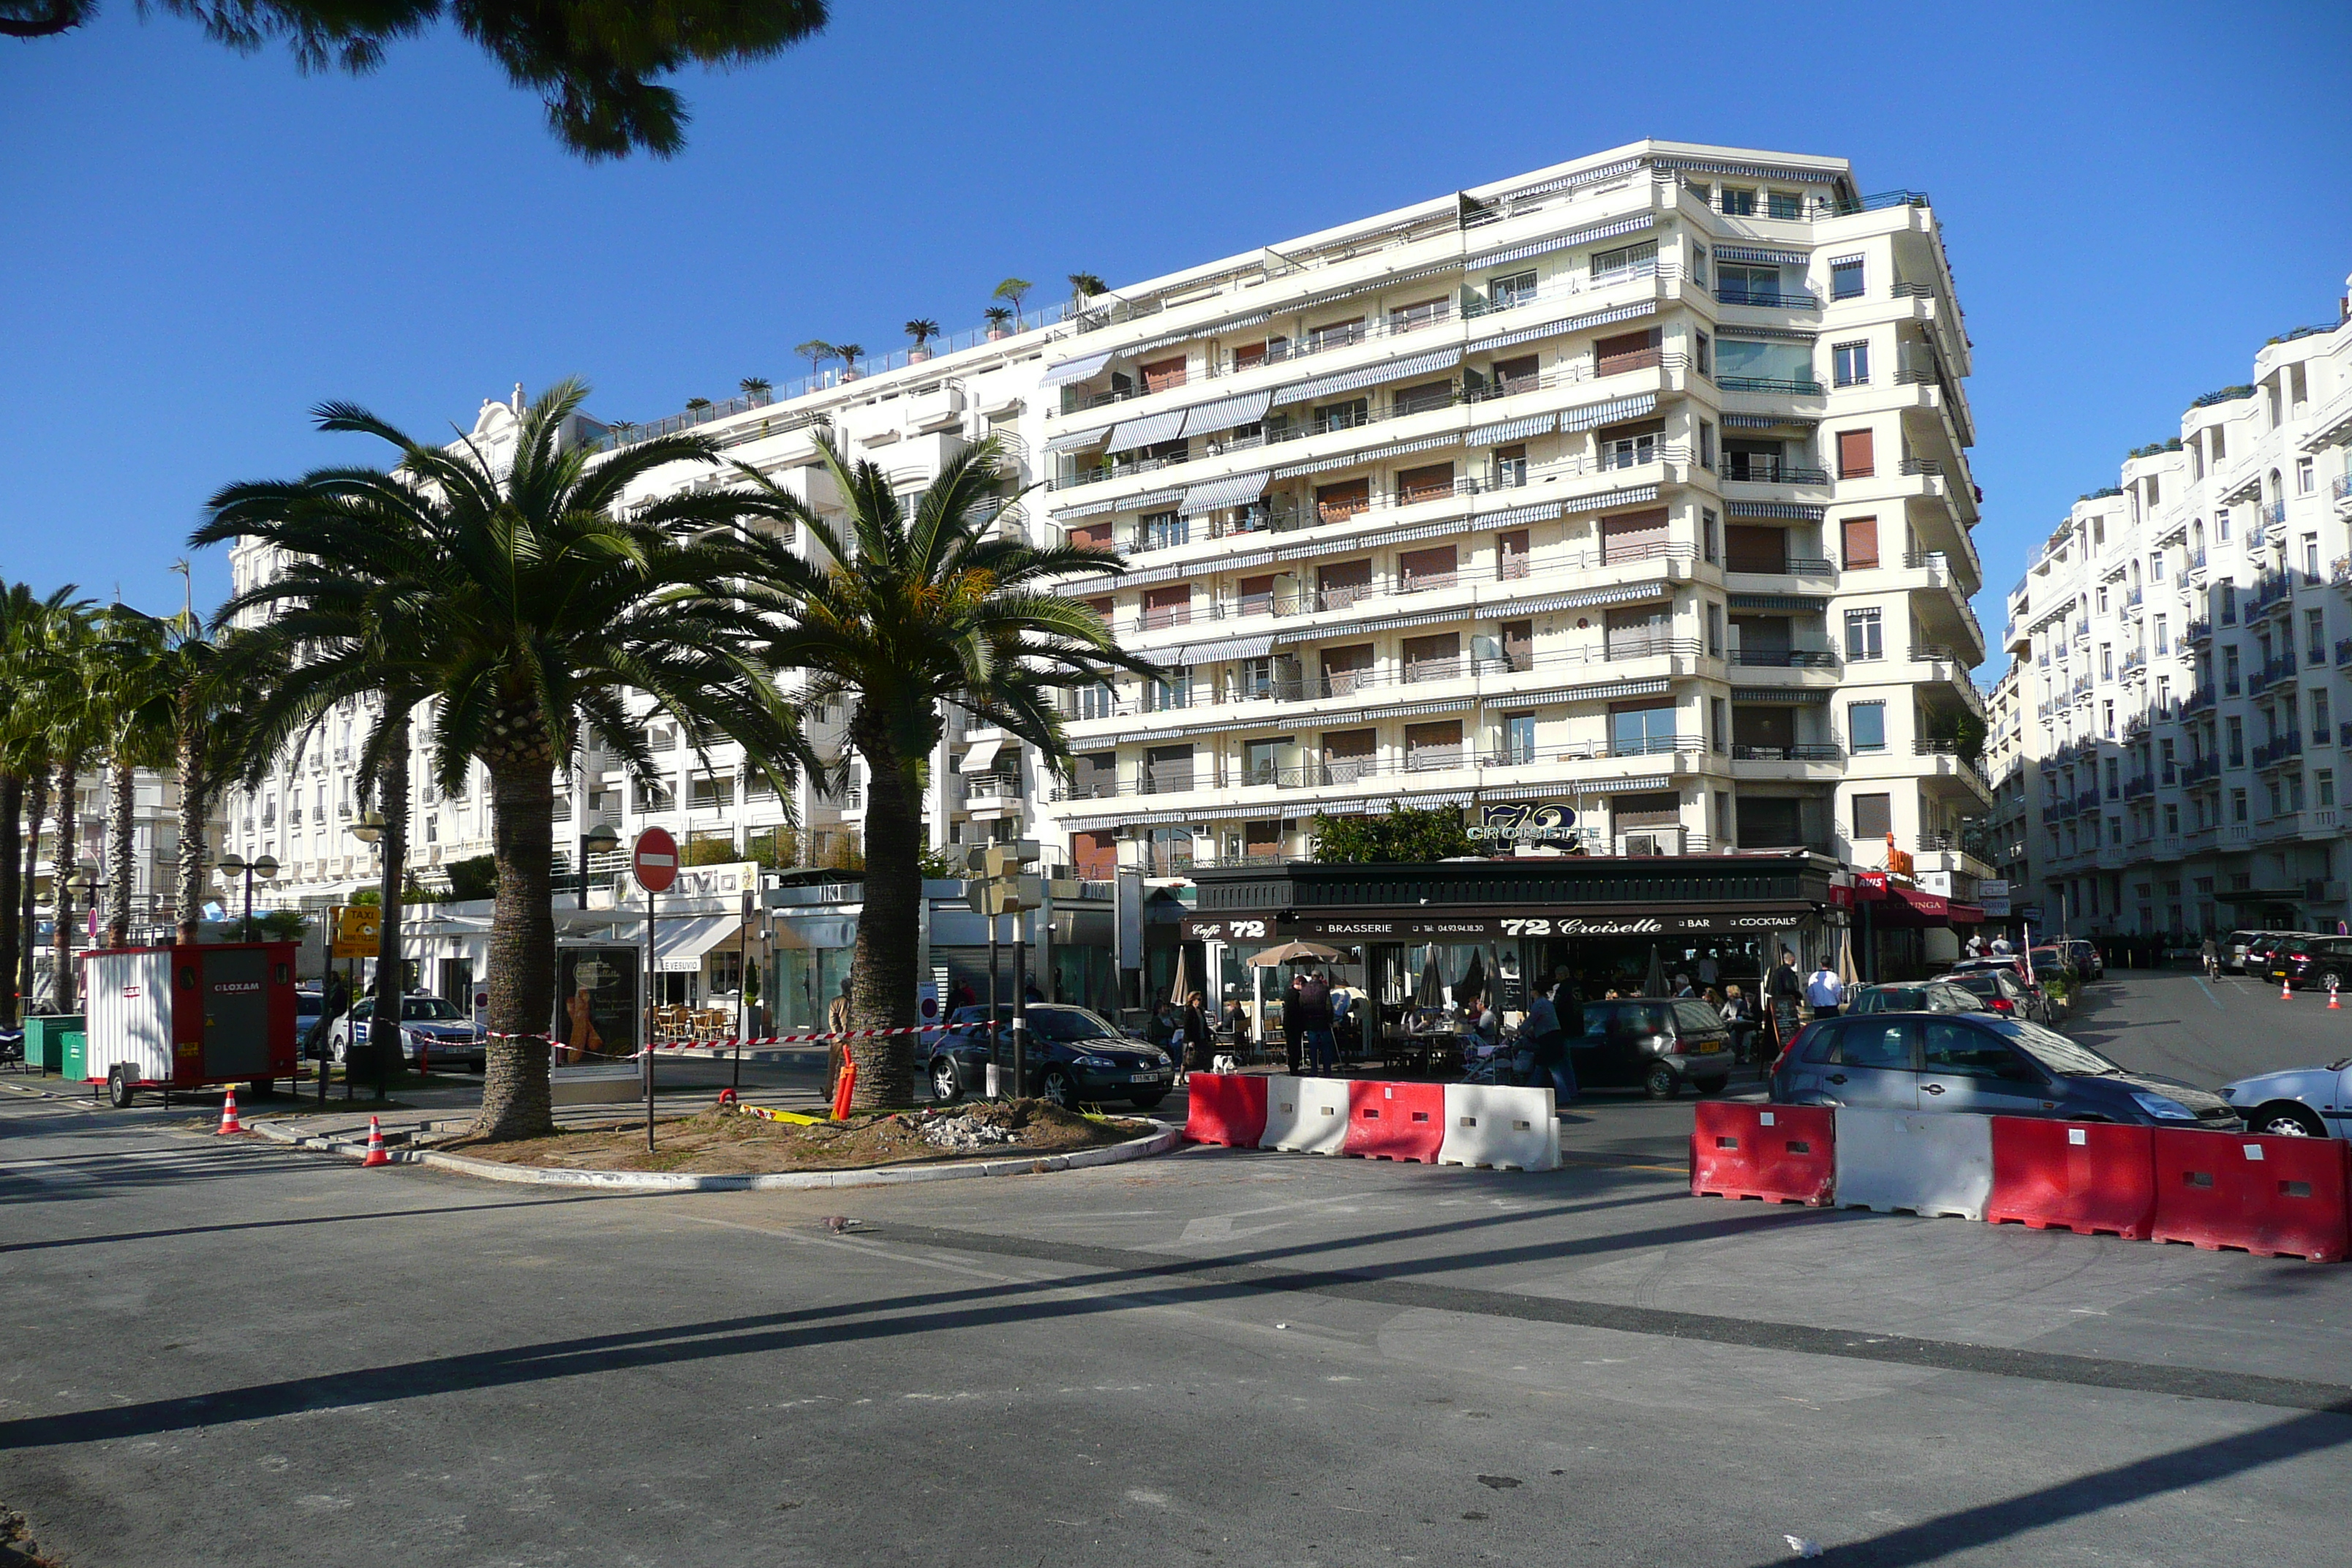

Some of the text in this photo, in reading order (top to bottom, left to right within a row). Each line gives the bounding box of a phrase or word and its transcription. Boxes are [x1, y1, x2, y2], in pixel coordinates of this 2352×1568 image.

[1482, 804, 1576, 851] 72
[1467, 826, 1600, 840] CROISETTE
[1859, 878, 1882, 886] AVIS
[350, 911, 374, 919] TAXI
[1230, 921, 1265, 938] 72
[1329, 924, 1392, 933] BRASSERIE
[1501, 917, 1797, 935] 72 Croisette BAR COCKTAILS
[670, 961, 698, 970] VESUVIO
[223, 983, 259, 992] LOXAM
